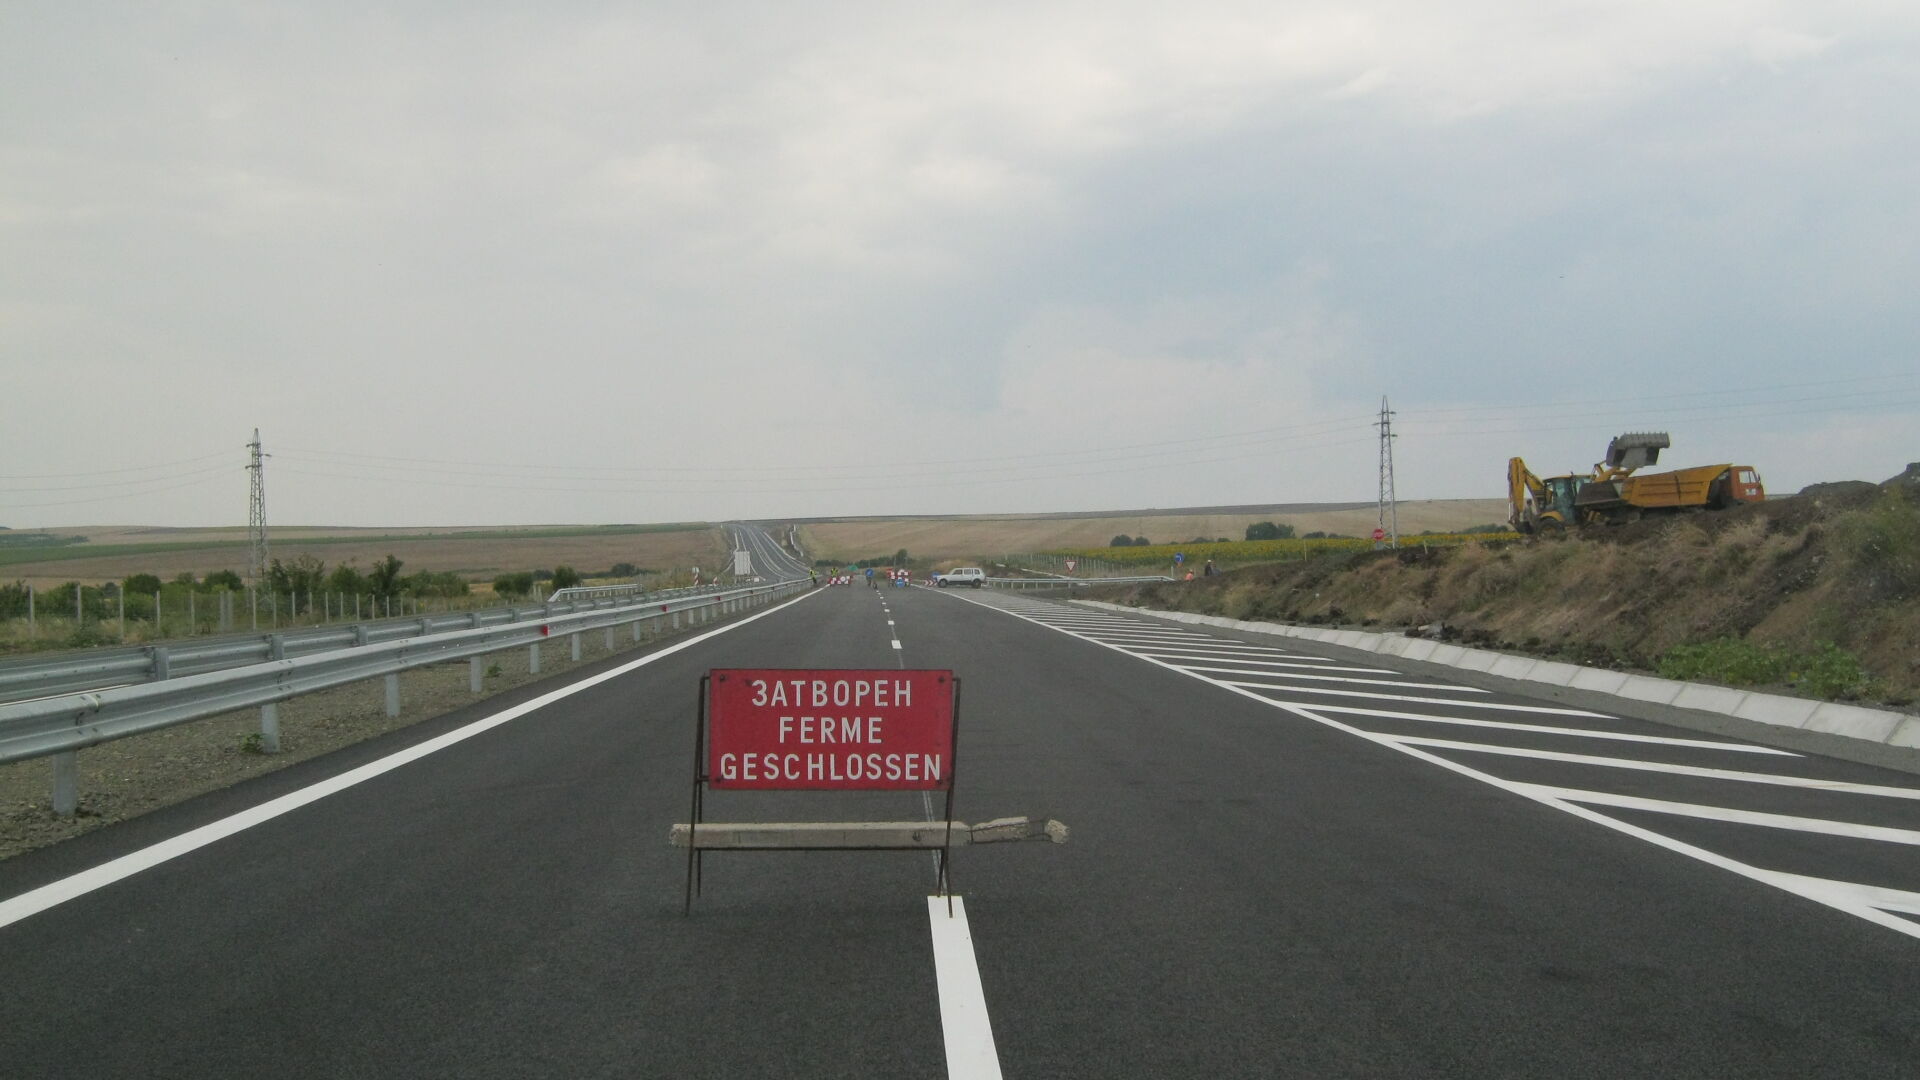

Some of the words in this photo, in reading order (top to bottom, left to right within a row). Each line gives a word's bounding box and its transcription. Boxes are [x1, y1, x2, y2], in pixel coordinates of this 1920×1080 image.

[752, 679, 911, 707] ЗАТВОРЕН
[779, 717, 882, 744] FERME
[720, 753, 940, 781] GESCHLOSSEN
